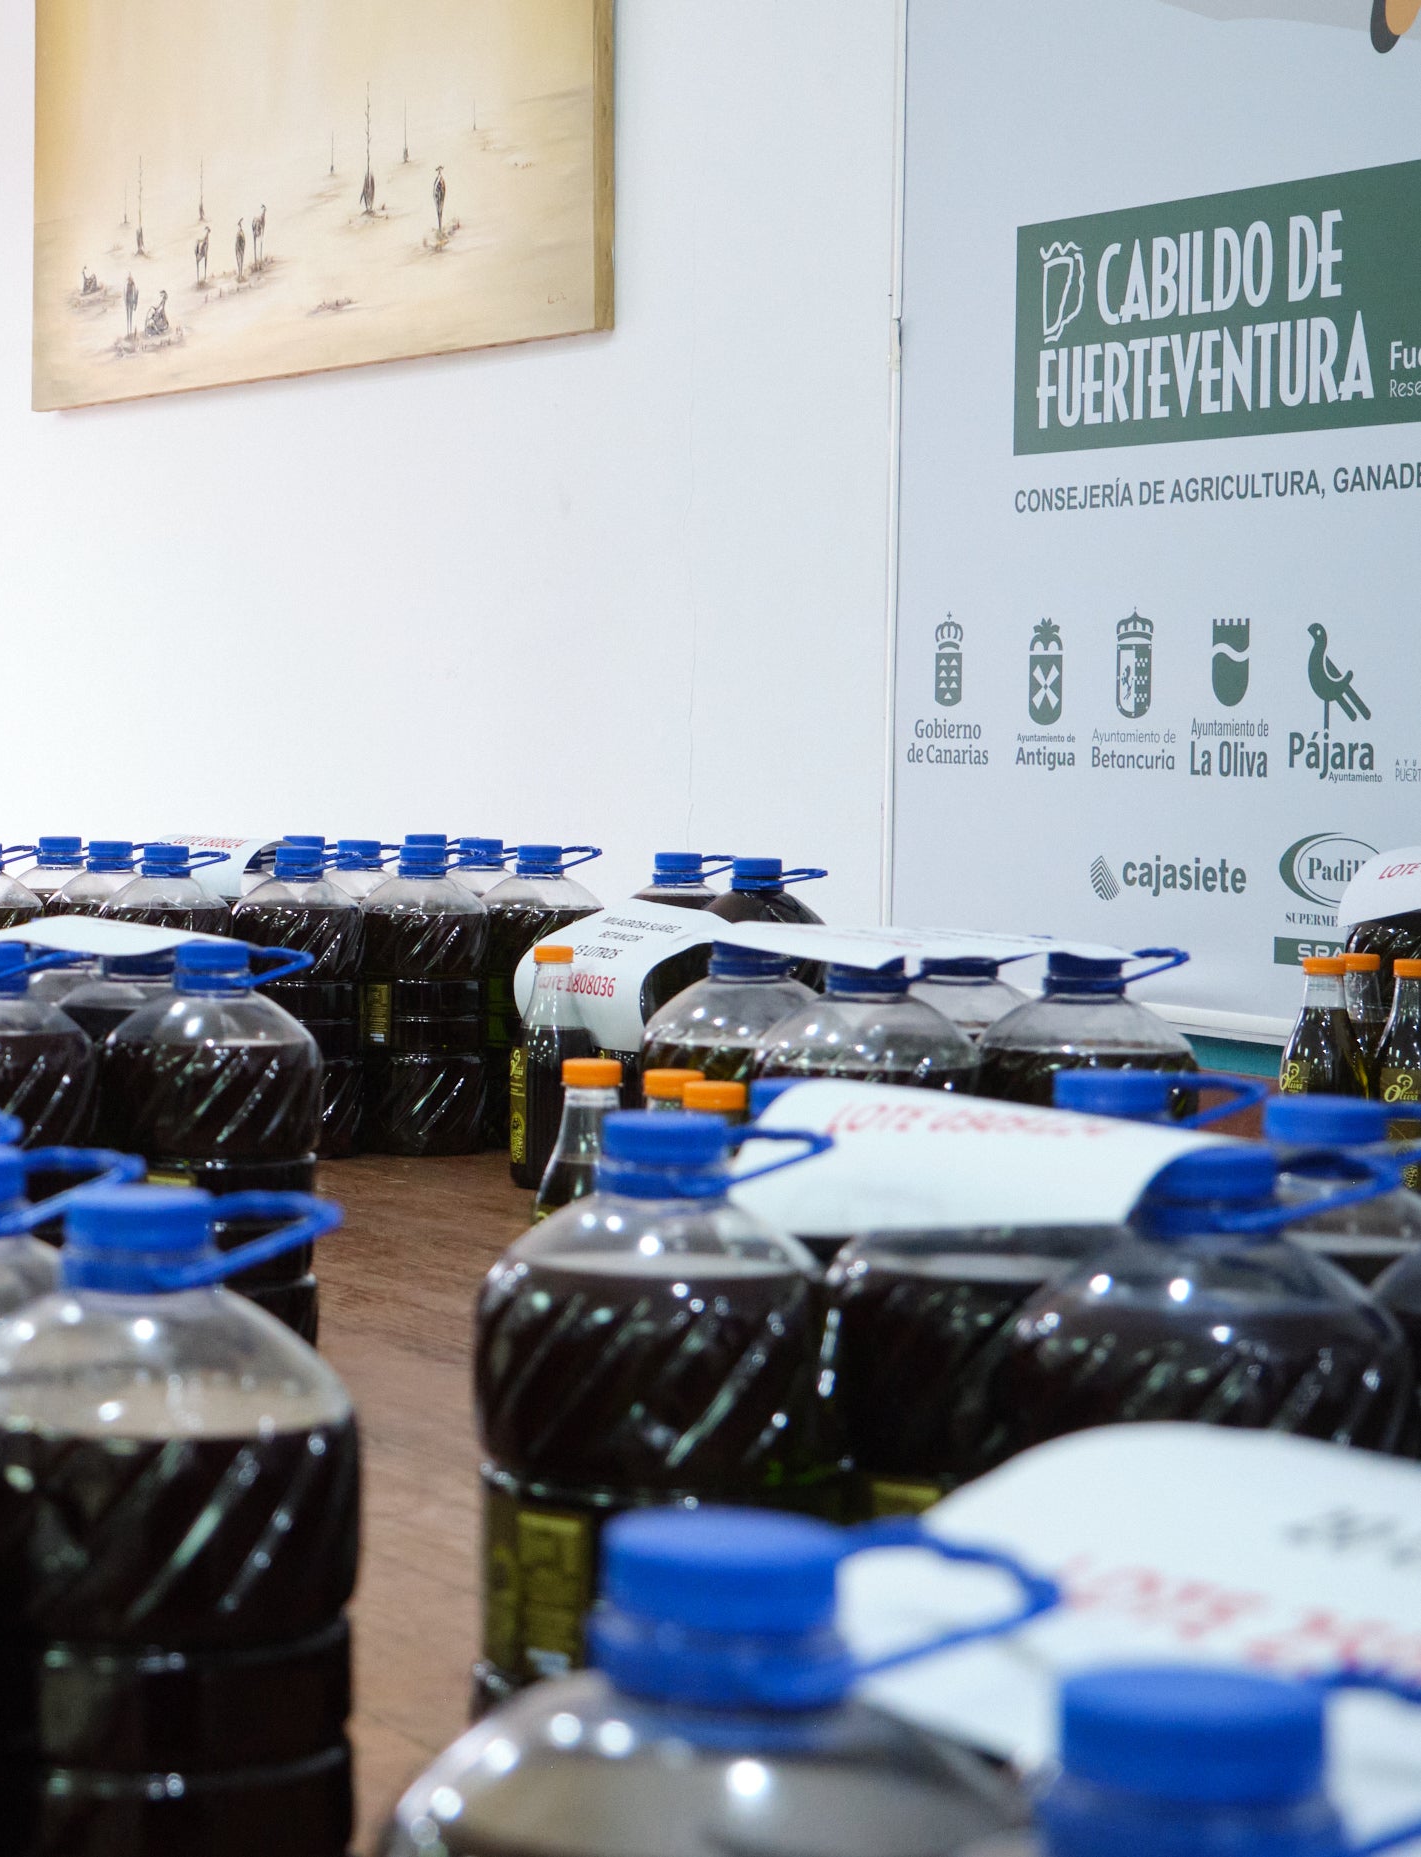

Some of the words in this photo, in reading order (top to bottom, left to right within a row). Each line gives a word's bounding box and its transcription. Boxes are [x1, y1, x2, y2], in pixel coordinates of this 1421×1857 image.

[1096, 220, 1274, 326] CABILDO
[1288, 208, 1343, 303] DE
[1390, 340, 1421, 371] Fu
[1036, 310, 1375, 430] FUERTEVENTURA
[1014, 477, 1134, 514] CONSEJERÍA
[1139, 480, 1165, 506] DE
[1169, 469, 1326, 505] AGRICULTURA,
[914, 718, 982, 740] Gobierno
[1016, 732, 1065, 745] Ayuntamiento
[1066, 733, 1076, 743] de
[1091, 727, 1160, 746] Ayuntamiento
[1163, 728, 1177, 744] de
[1190, 717, 1255, 739] Ayuntamiento
[1256, 719, 1269, 738] de
[906, 743, 924, 763] de
[926, 743, 989, 765] Canarias
[1015, 746, 1076, 771] Antigua
[1091, 746, 1176, 771] Betancuria
[1190, 741, 1211, 776] La
[1218, 740, 1268, 778] Oliva
[1288, 731, 1375, 780] Pájara
[1328, 770, 1383, 783] Ayuntamiento
[1122, 854, 1247, 896] cajasiete
[1378, 862, 1420, 880] LOTE
[602, 916, 649, 931] MILAGROSA
[646, 920, 682, 934] SUÁREZ
[598, 931, 644, 943] BETANCOR
[584, 946, 623, 960] LITROS
[565, 972, 616, 998] 1808036
